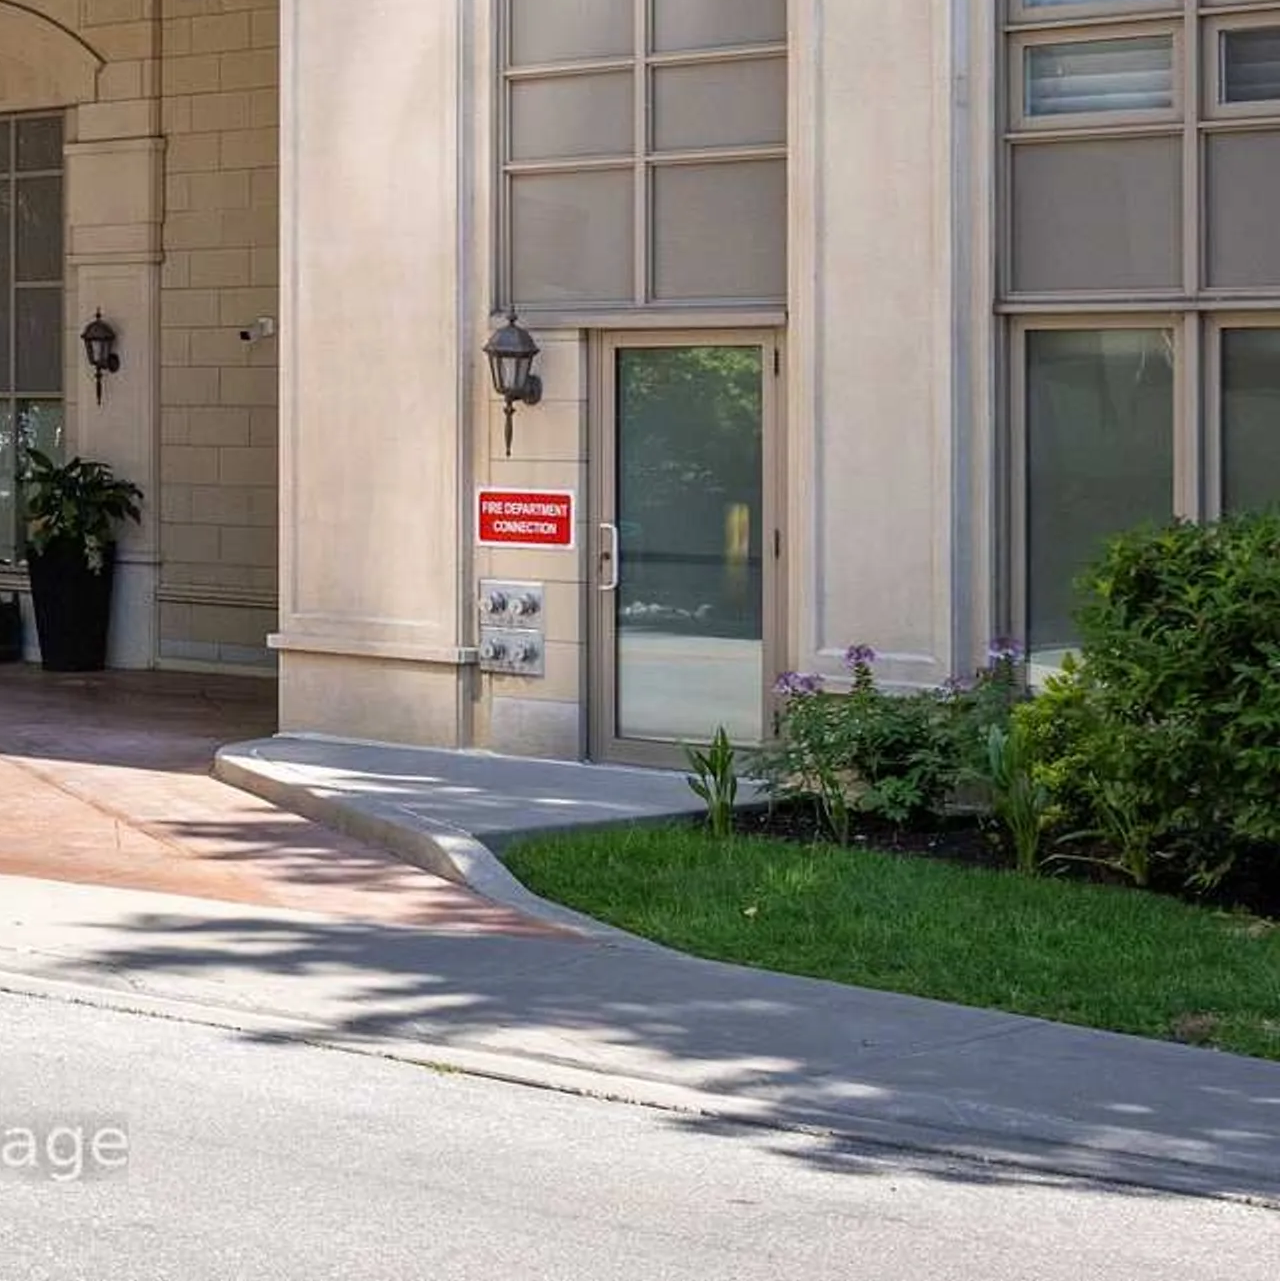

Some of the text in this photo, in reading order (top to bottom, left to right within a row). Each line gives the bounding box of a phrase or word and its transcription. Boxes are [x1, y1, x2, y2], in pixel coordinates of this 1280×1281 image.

[481, 500, 568, 517] FIRE DEPARTMENT
[493, 520, 557, 534] CONNECTION
